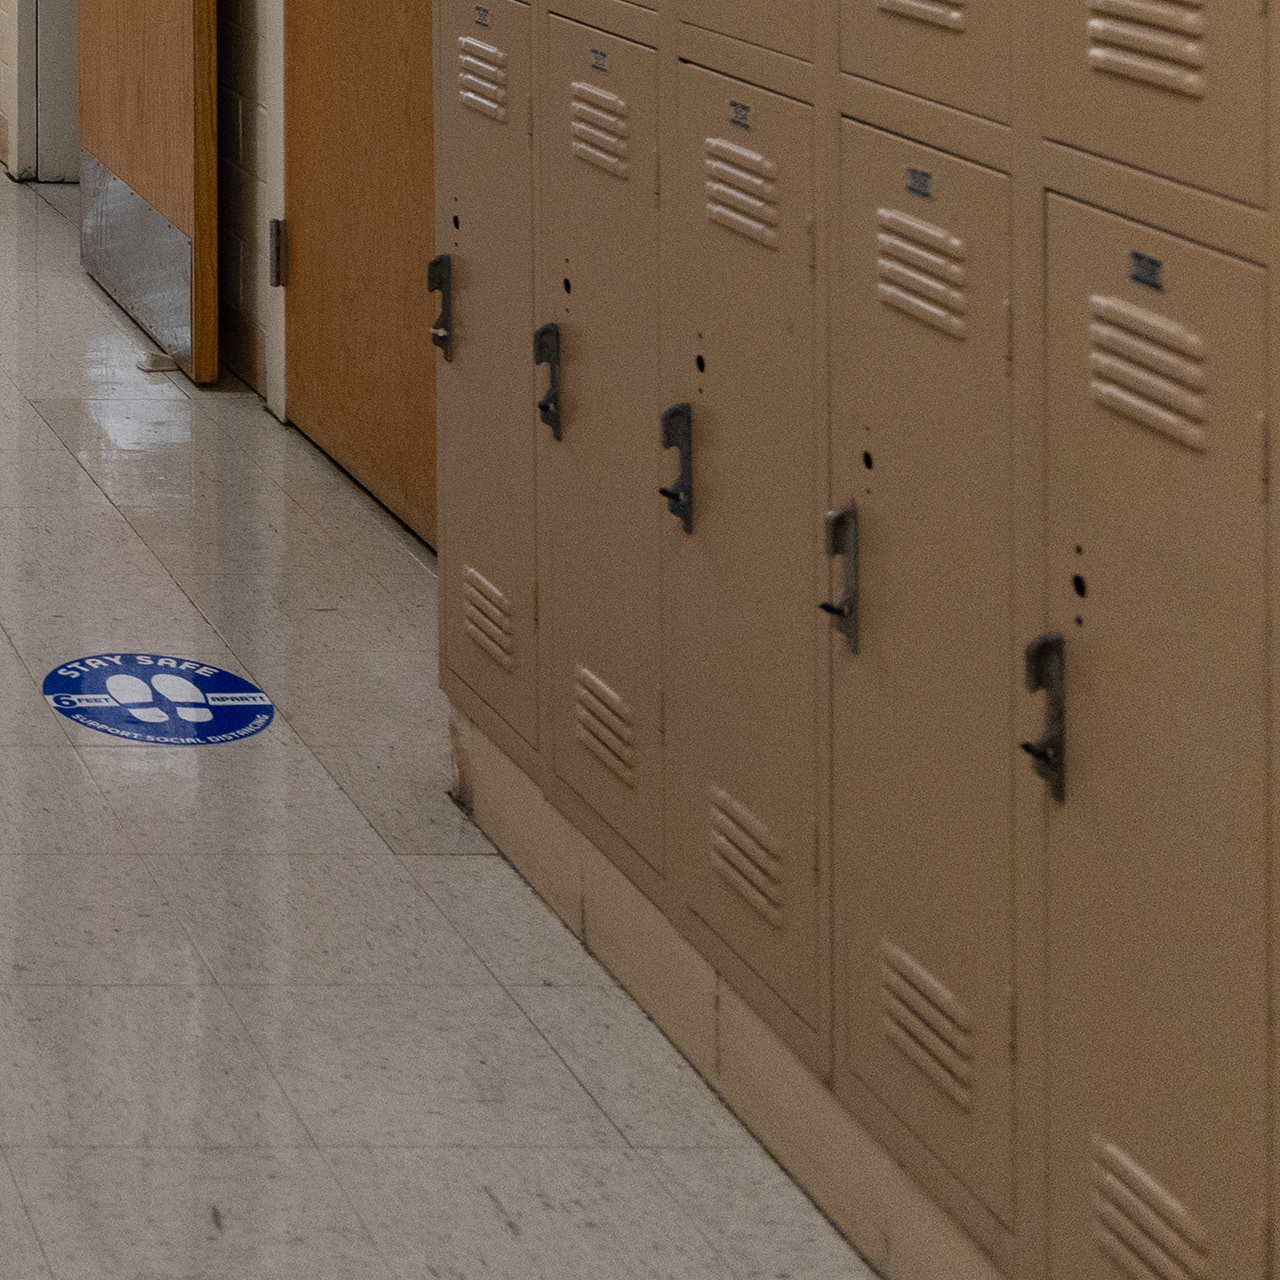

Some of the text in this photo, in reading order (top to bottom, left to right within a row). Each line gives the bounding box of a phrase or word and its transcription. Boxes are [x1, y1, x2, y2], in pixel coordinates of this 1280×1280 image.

[57, 655, 220, 679] STAY SAFE
[53, 693, 78, 709] 6
[71, 714, 270, 744] SUPPORT SOCIAL DISTANCING
